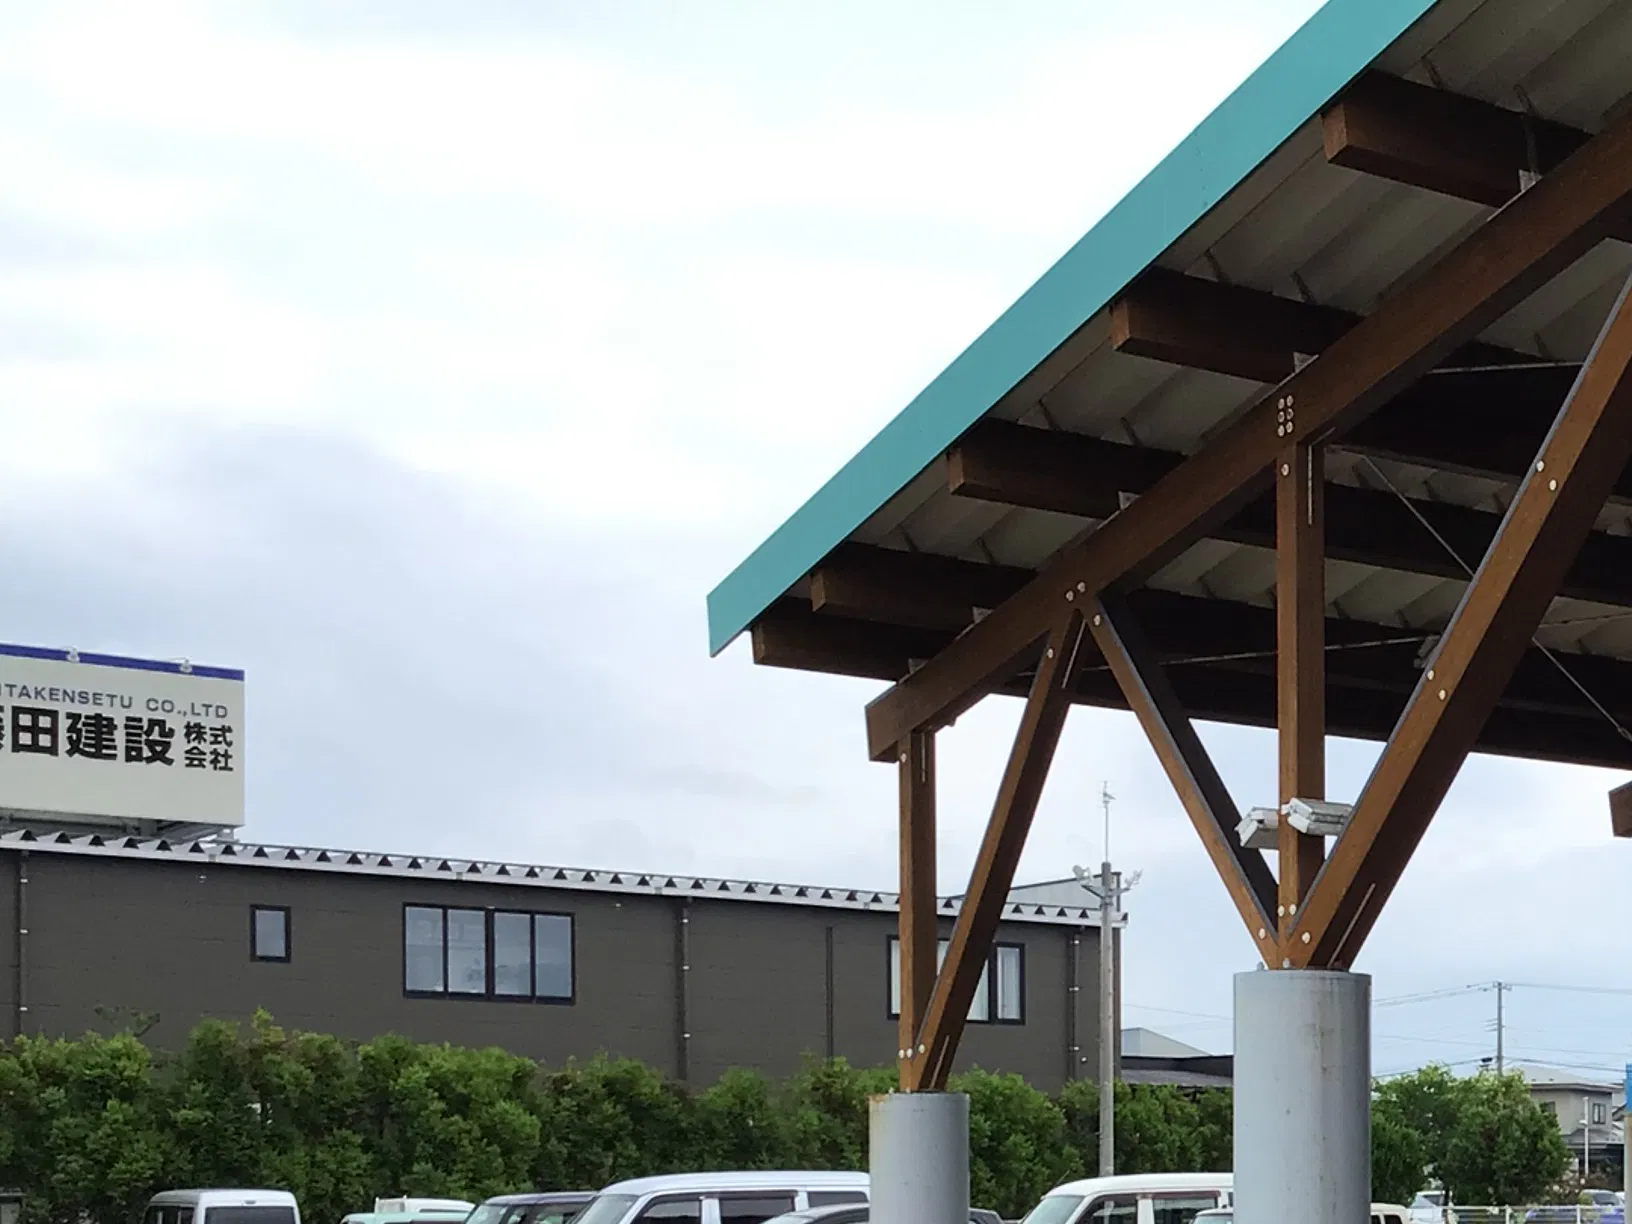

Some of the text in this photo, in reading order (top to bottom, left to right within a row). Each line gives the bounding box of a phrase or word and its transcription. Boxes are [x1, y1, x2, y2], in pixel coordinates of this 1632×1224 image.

[0, 683, 229, 719] TAKENSETU CO.,LTD
[0, 704, 175, 766] 田建設
[184, 721, 233, 748] 株式
[184, 746, 234, 772] 会社
